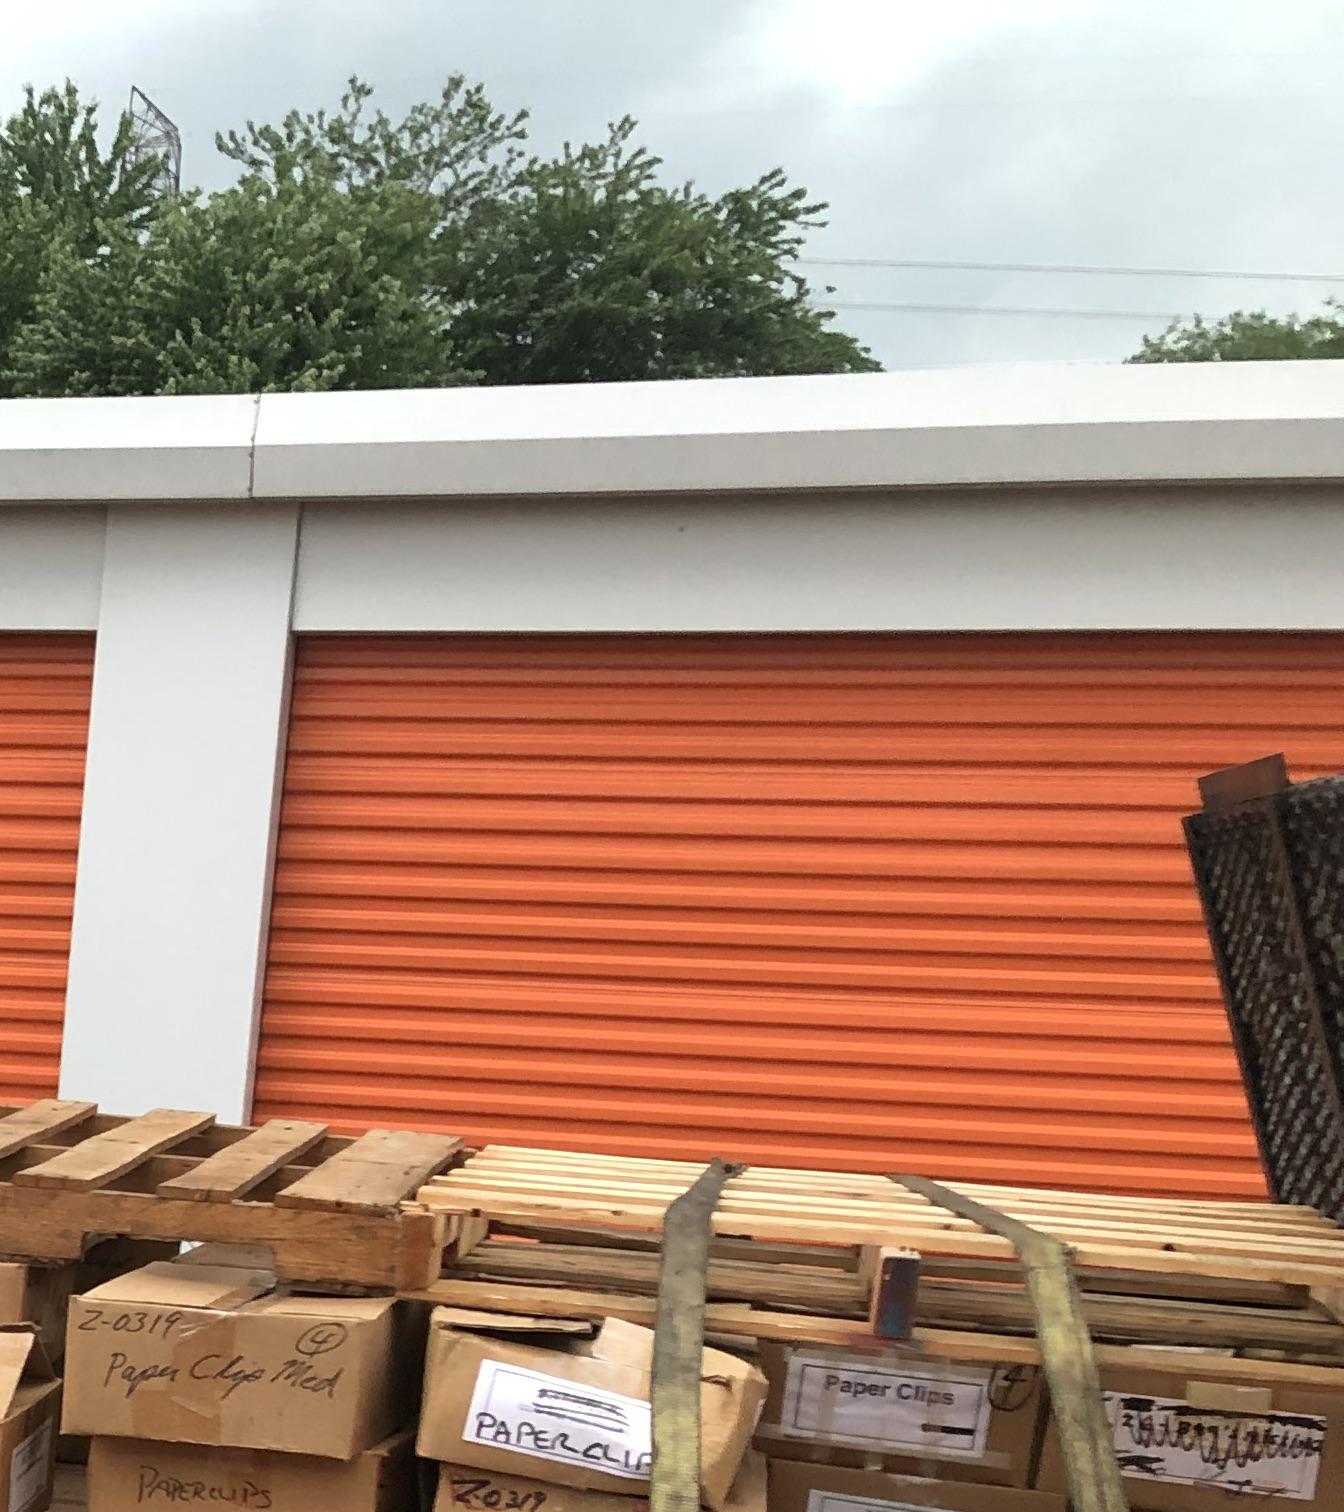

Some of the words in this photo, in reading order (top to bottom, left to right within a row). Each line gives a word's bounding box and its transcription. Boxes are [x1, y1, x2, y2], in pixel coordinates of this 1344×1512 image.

[77, 1309, 184, 1339] Z-0319
[103, 1351, 180, 1400] Paper
[823, 1374, 891, 1398] Paper
[895, 1382, 956, 1407] Clips
